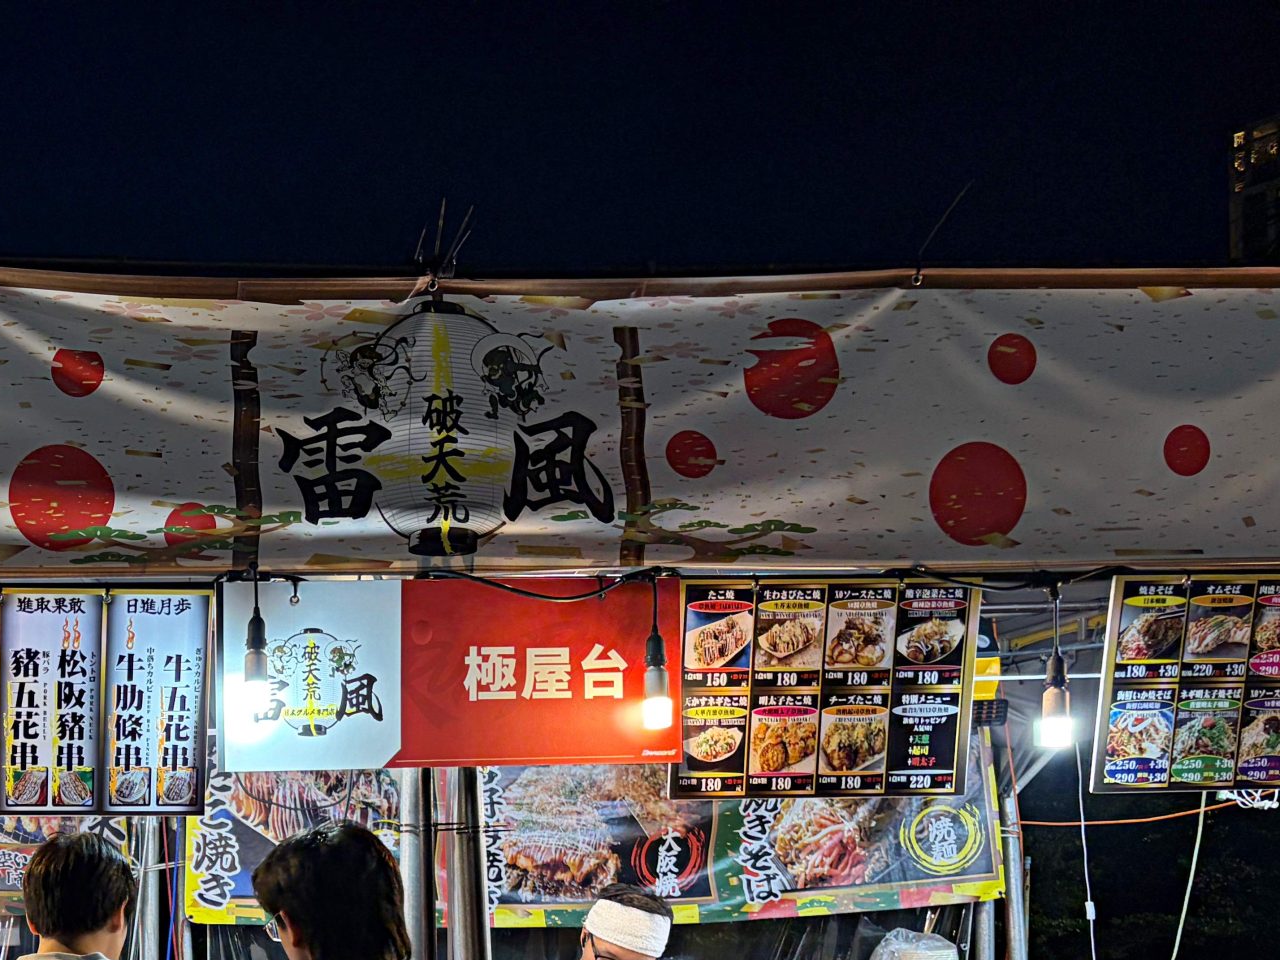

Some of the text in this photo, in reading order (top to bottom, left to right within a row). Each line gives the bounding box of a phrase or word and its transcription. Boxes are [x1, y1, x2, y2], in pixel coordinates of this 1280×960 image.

[422, 389, 470, 523] 破天荒
[504, 411, 614, 523] 風
[127, 598, 192, 615] 日進月歩
[302, 643, 322, 701] 破天荒
[463, 643, 628, 702] 極屋台
[1126, 664, 1147, 677] 180
[1193, 664, 1213, 677] 220
[706, 673, 727, 686] 150
[777, 672, 798, 686] 180
[847, 672, 868, 685] 180
[917, 671, 939, 685] 180
[336, 673, 383, 722] 風
[115, 653, 145, 771] 牛肋條串
[161, 654, 192, 771] 牛五花串
[1115, 761, 1135, 769] 250
[1183, 760, 1202, 769] 250
[1248, 758, 1268, 767] 250
[910, 776, 931, 788] 220
[1115, 773, 1134, 782] 290
[1182, 772, 1201, 782] 290
[1247, 771, 1266, 780] 290
[700, 778, 722, 792] 180
[771, 777, 792, 791] 180
[841, 776, 861, 789] 180
